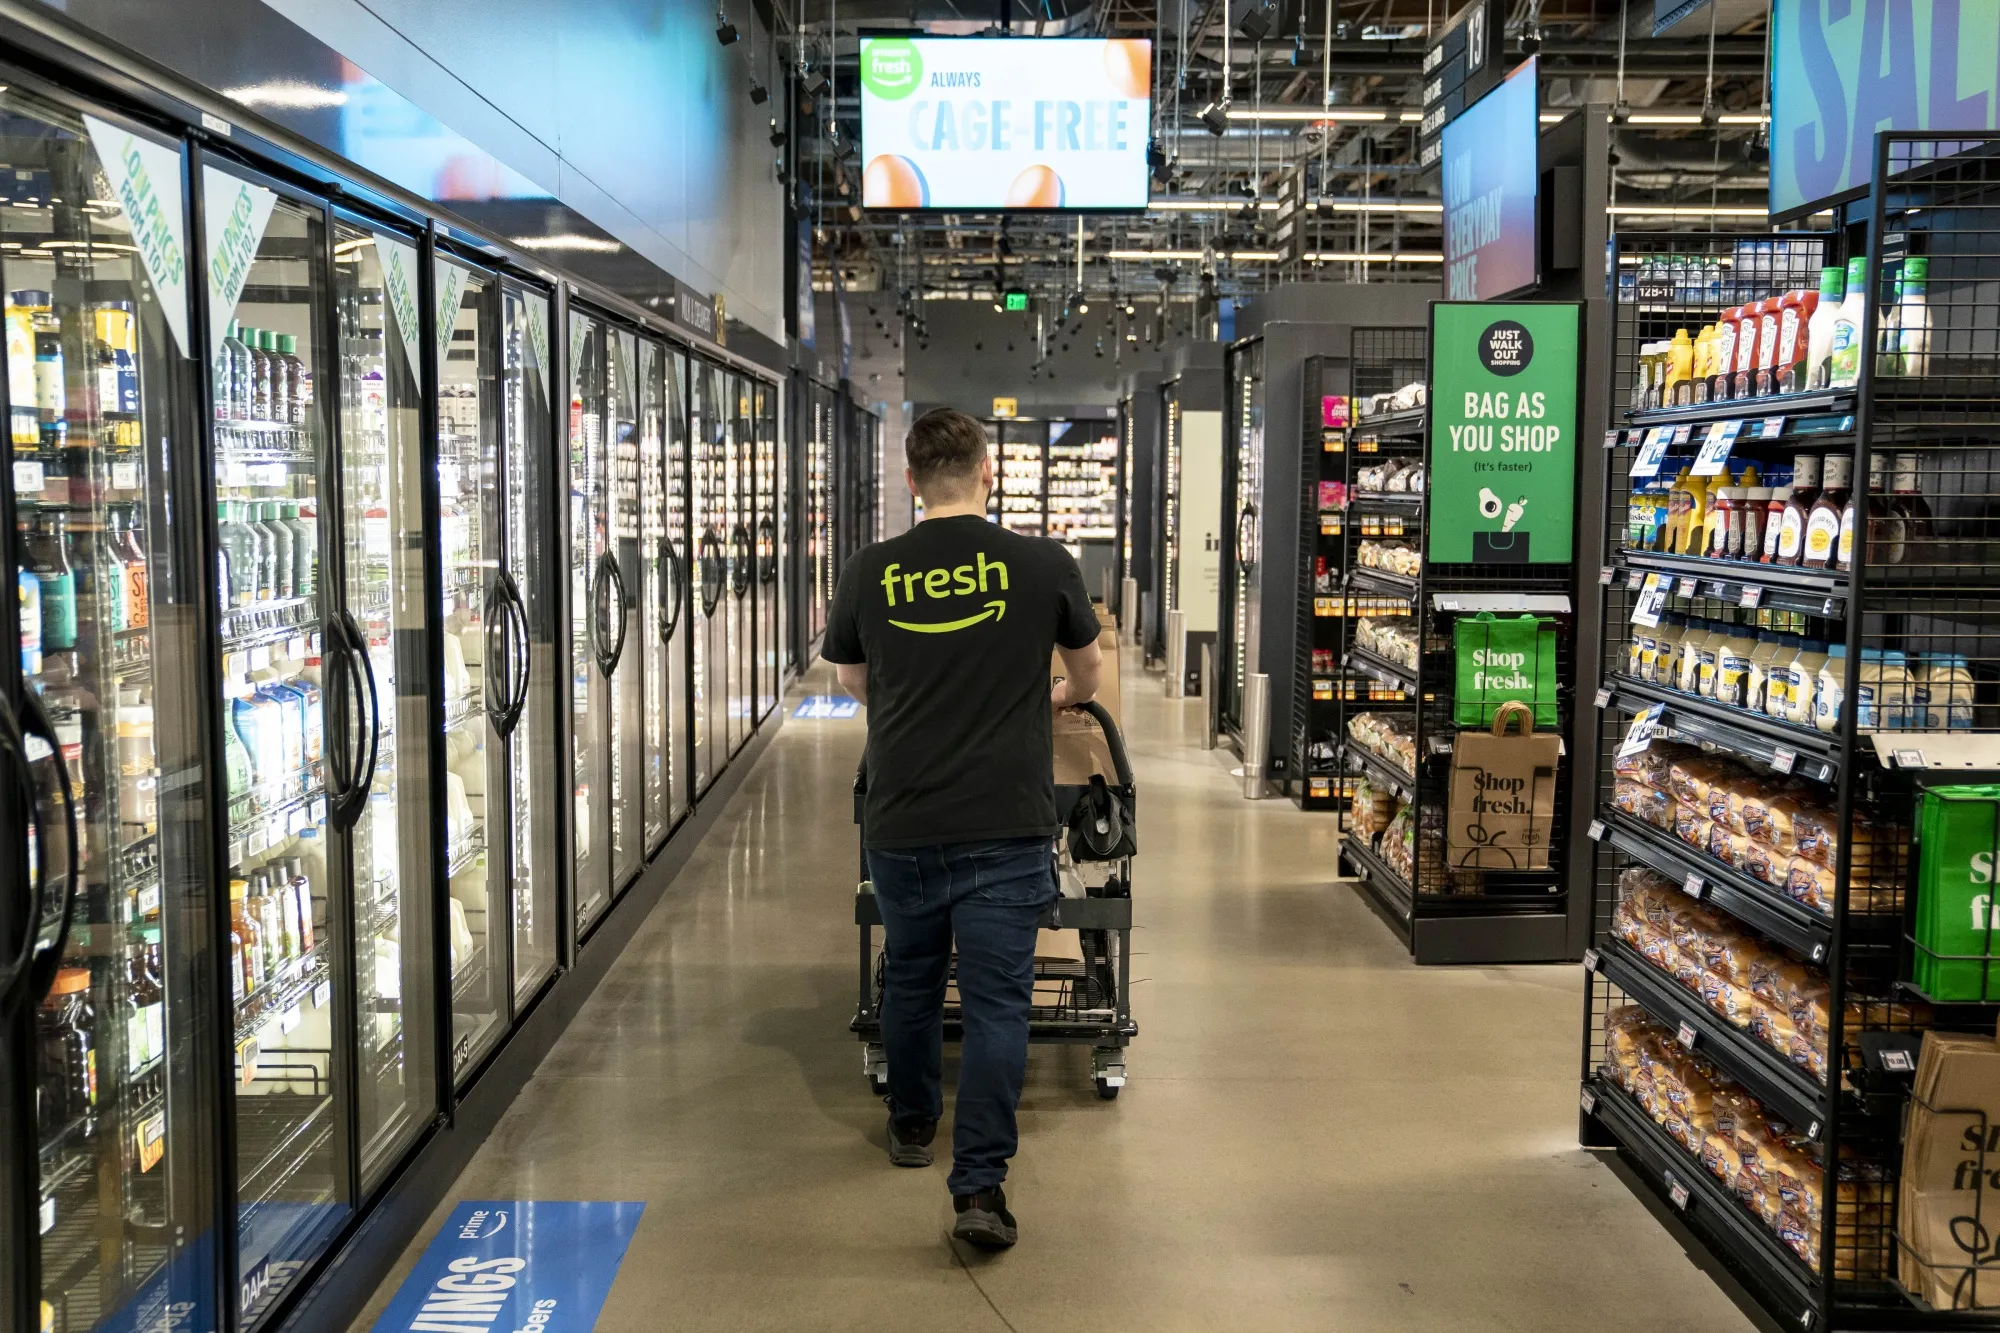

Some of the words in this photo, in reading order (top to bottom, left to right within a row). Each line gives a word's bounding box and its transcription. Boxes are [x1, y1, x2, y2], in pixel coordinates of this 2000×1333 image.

[1468, 10, 1483, 70] 13
[871, 57, 911, 74] fresh
[931, 72, 981, 88] ALWAYS
[1793, 0, 2000, 203] SAL
[909, 100, 1128, 151] CAGE-FREE
[1450, 149, 1471, 210] LOW
[121, 135, 152, 202] LOW
[146, 192, 183, 286] PRICES
[223, 183, 254, 250] PRICES
[120, 179, 146, 235] FROM
[141, 232, 151, 252] A
[149, 247, 162, 276] TO
[1450, 184, 1504, 261] EVERYDAY
[224, 268, 242, 307] FROM
[1639, 285, 1675, 299] 12B-11
[1489, 340, 1522, 350] WALK
[1492, 330, 1520, 340] JUST
[1493, 350, 1518, 360] OUT
[1464, 392, 1509, 419] BAG
[1515, 392, 1545, 419] AS
[1449, 425, 1493, 452] YOU
[1500, 425, 1560, 452] SHOP
[1474, 462, 1494, 473] (It's
[1498, 462, 1532, 473] faster)
[881, 552, 1009, 607] fresh
[1823, 598, 1834, 616] E
[1472, 648, 1525, 671] Shop
[1474, 671, 1533, 690] fresh.
[1818, 764, 1829, 780] D
[1473, 772, 1525, 796] Shop
[1472, 796, 1532, 816] fresh.
[1812, 944, 1823, 960] C
[1808, 1121, 1818, 1138] B
[459, 1210, 490, 1240] prime
[241, 1263, 270, 1312] DAI-4
[1801, 1309, 1811, 1326] A
